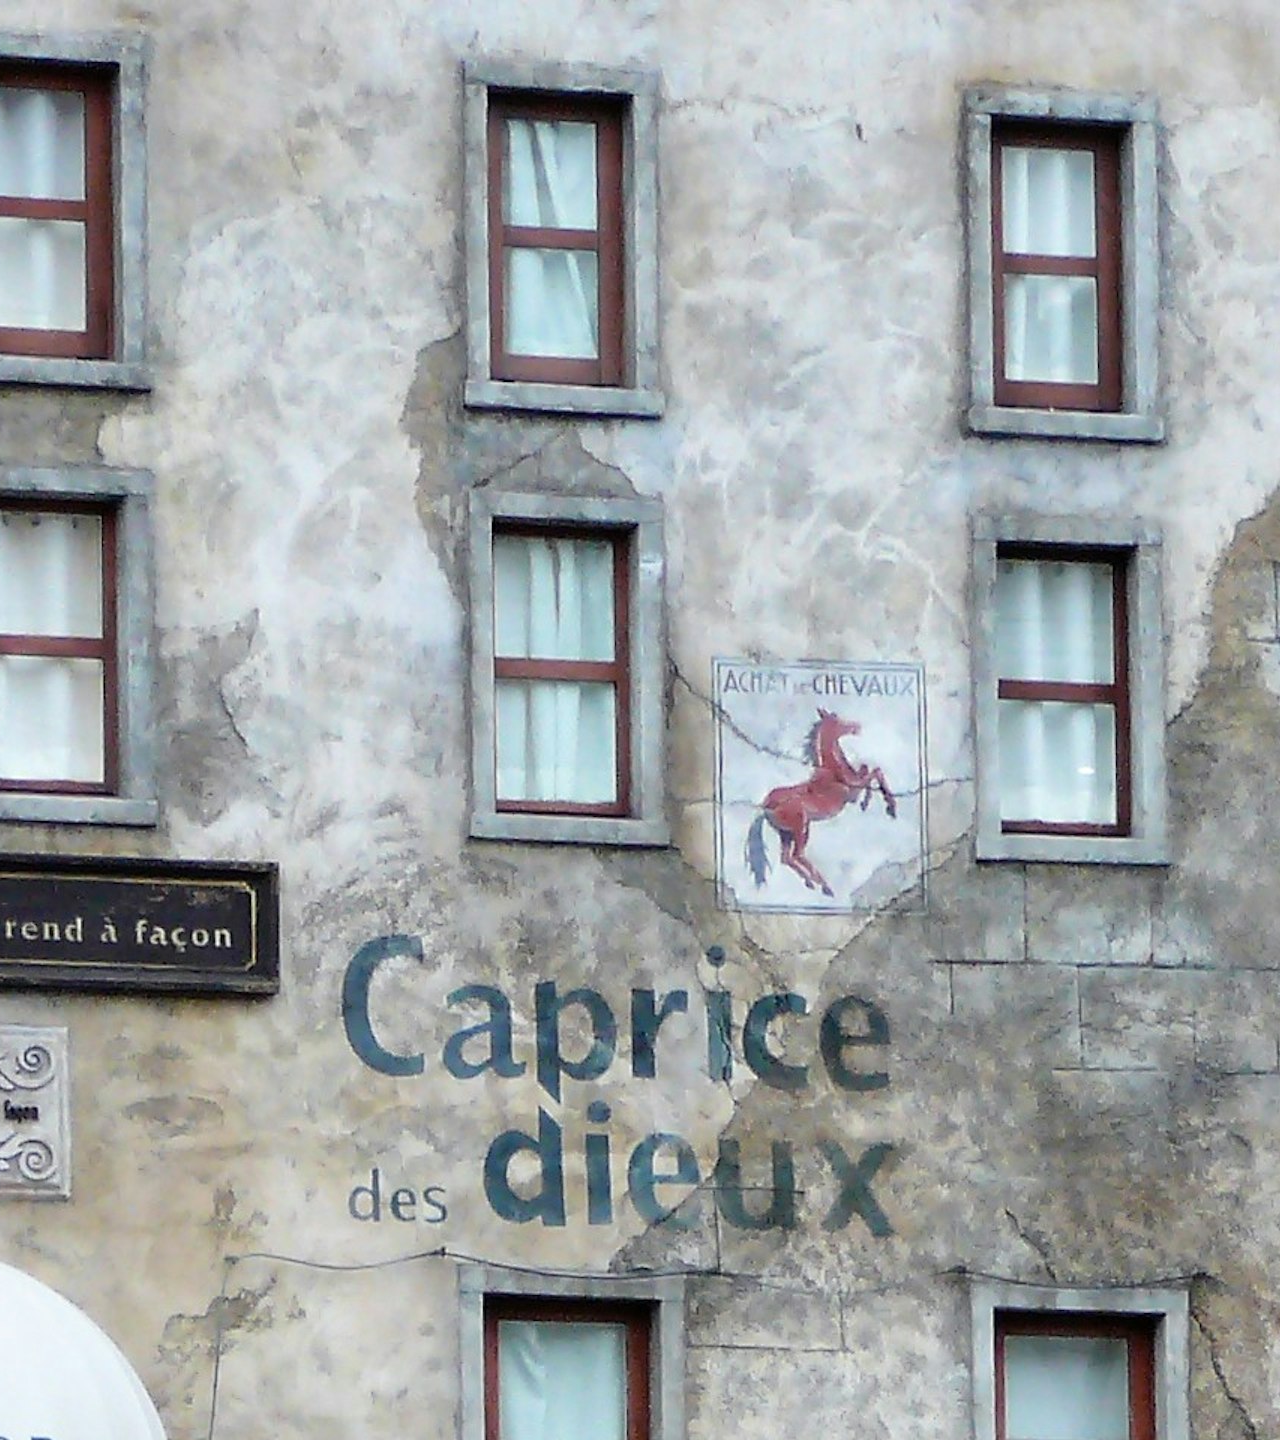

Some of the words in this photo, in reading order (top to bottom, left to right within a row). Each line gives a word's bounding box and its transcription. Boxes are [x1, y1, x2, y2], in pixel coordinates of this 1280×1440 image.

[723, 669, 788, 694] ACHAT
[812, 673, 916, 697] CHEVAUX
[4, 915, 85, 944] rend
[102, 917, 119, 945] à
[134, 919, 232, 951] façon
[342, 934, 892, 1104] Caprice
[348, 1168, 448, 1223] des
[483, 1101, 902, 1238] dieux
